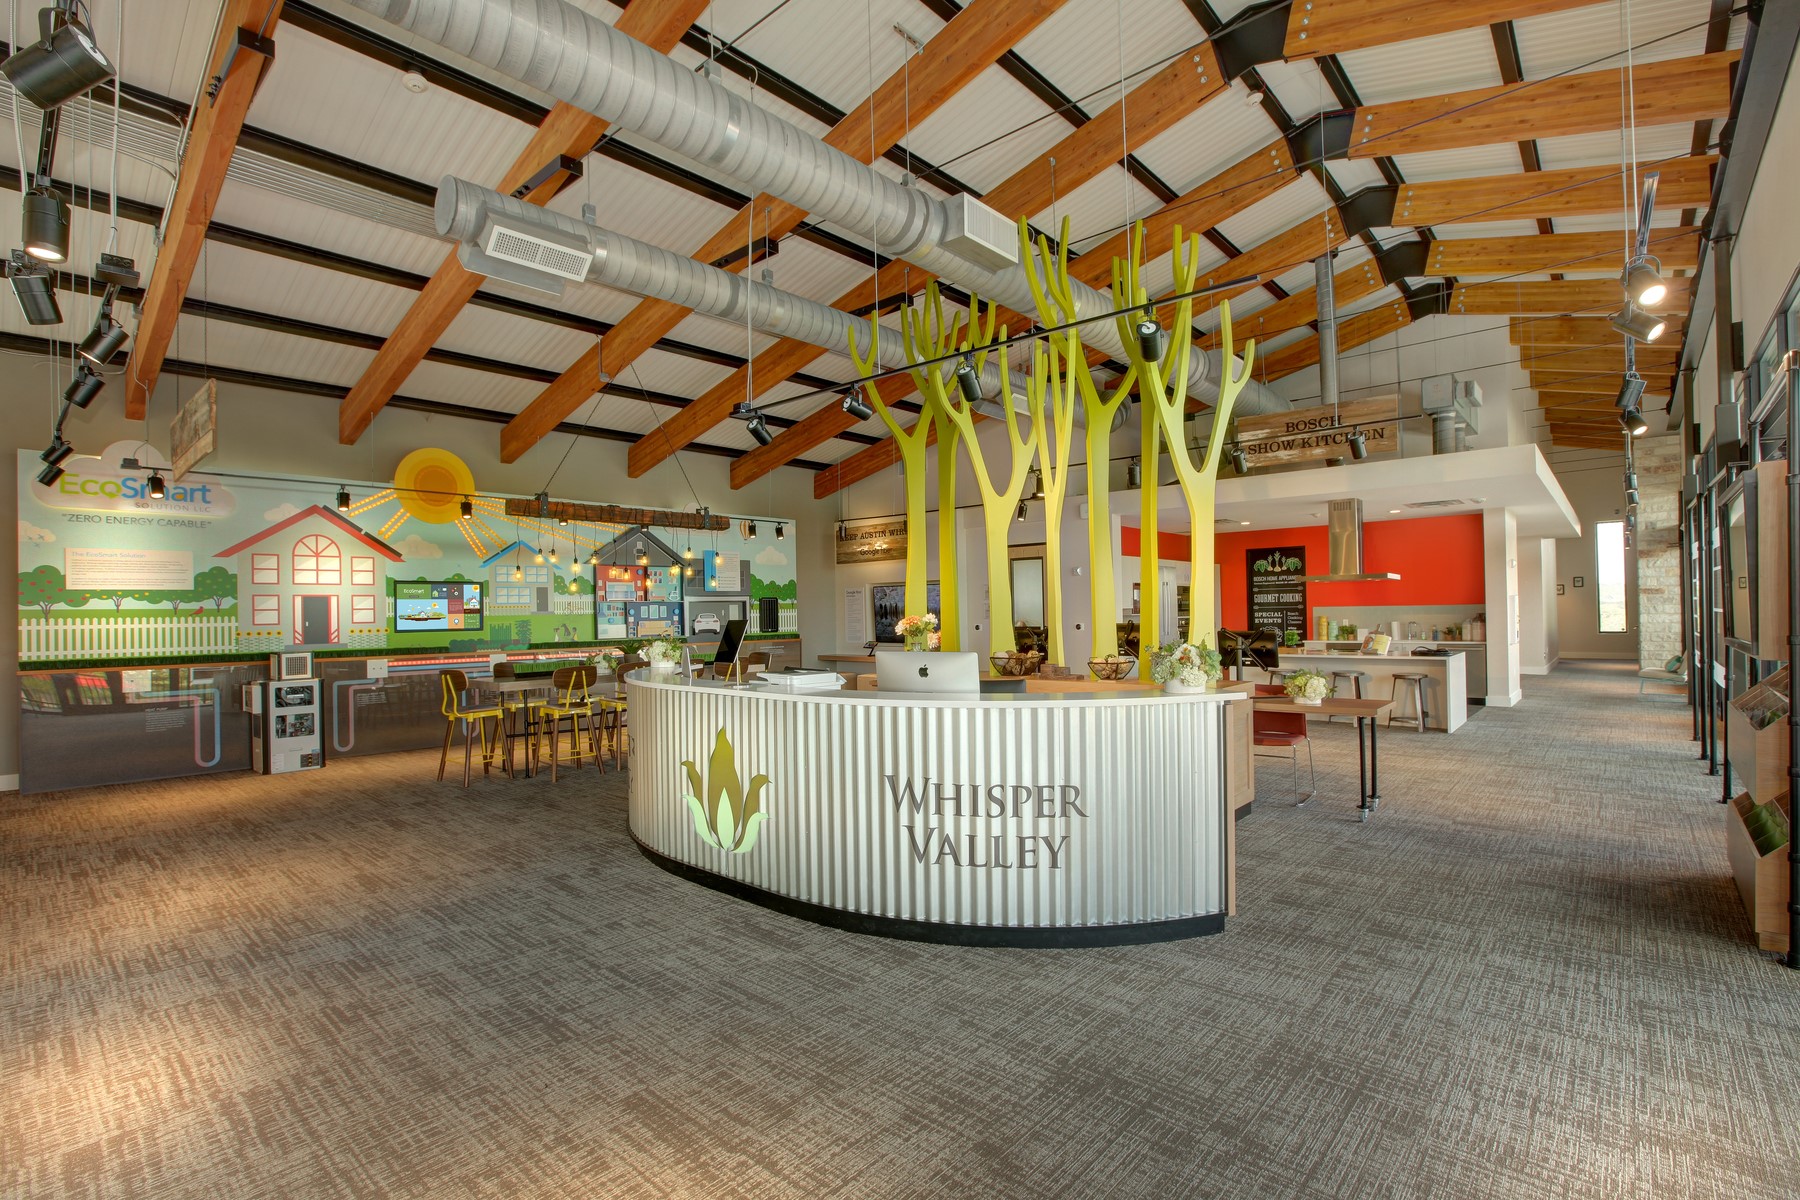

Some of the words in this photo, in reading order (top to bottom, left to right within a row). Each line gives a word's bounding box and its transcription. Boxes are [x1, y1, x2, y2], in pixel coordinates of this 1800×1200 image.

[1285, 415, 1343, 433] BOSCH
[1248, 440, 1295, 455] SHOW
[135, 502, 191, 512] SOLUTION
[106, 516, 155, 526] ENERGY
[860, 530, 887, 539] AUSTIN
[860, 548, 879, 556] Google
[1254, 594, 1279, 603] GOURMET
[1280, 593, 1303, 602] COOKING
[883, 774, 1090, 819] WHISPER
[902, 825, 1071, 869] VALLEY
